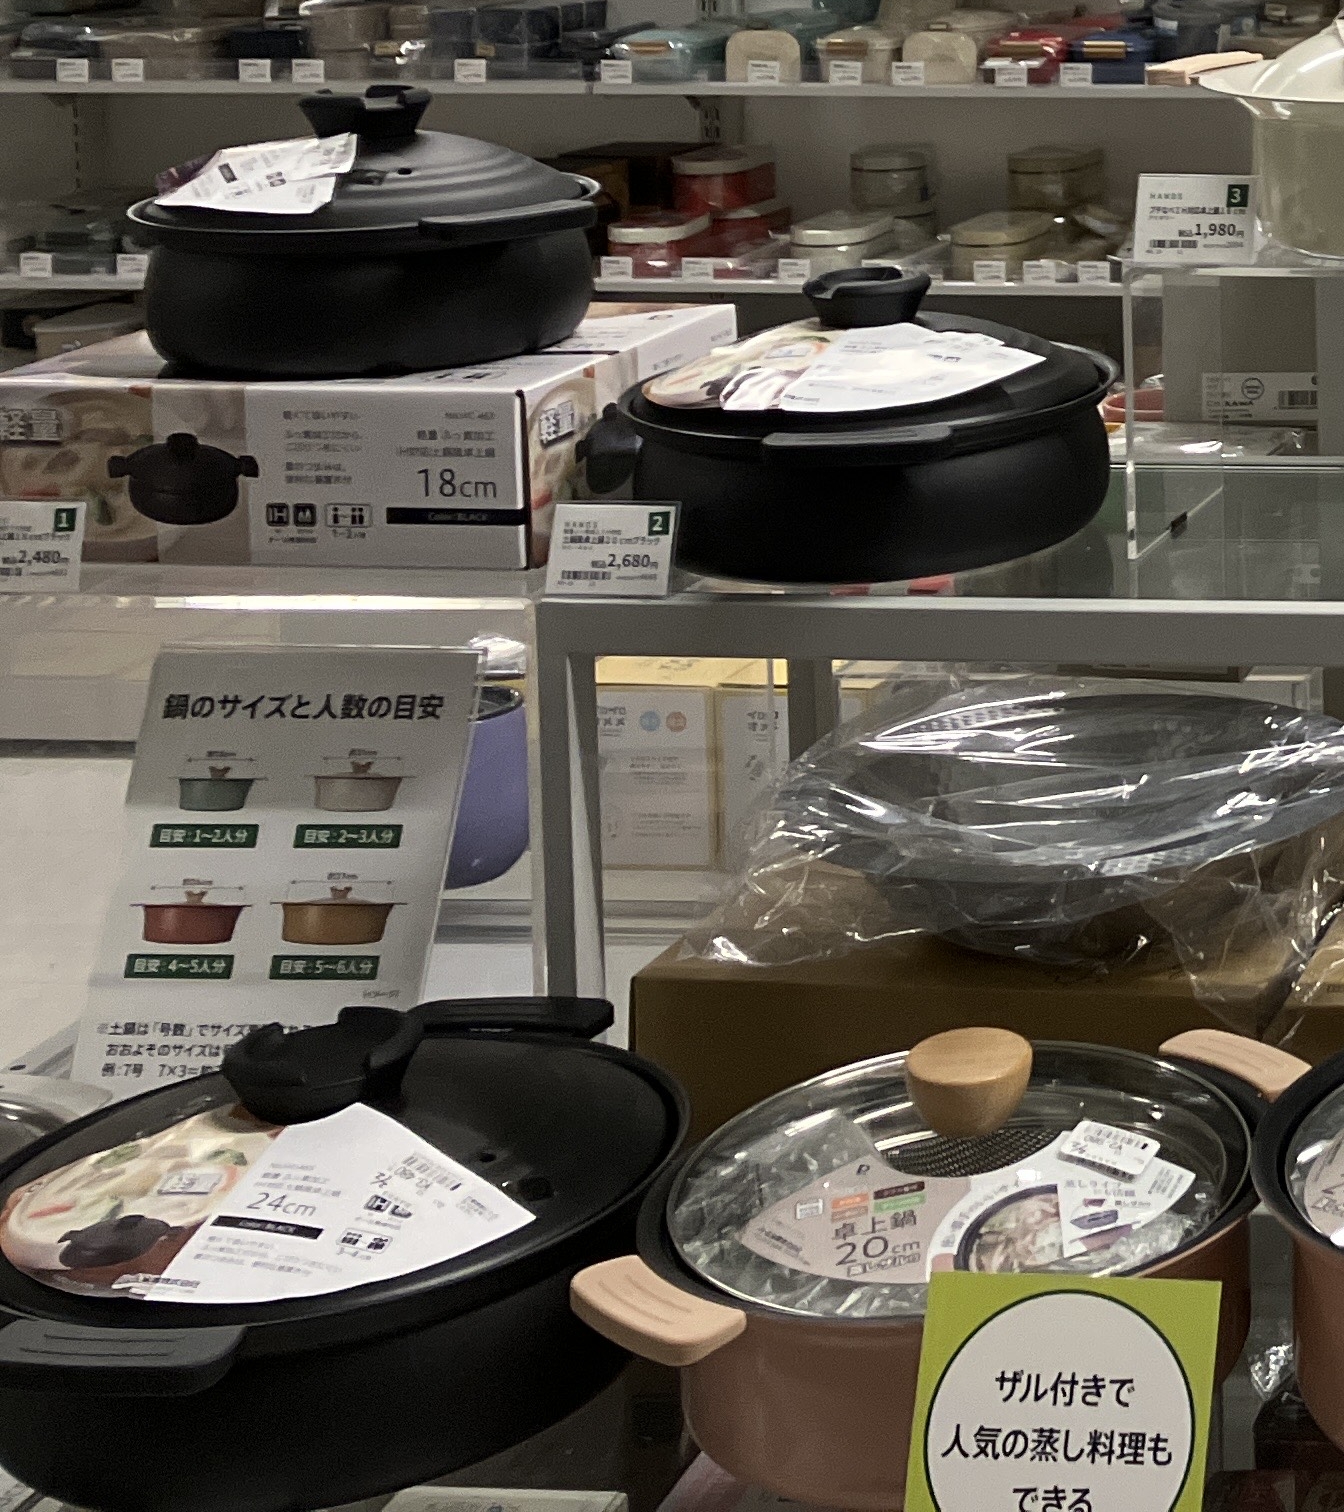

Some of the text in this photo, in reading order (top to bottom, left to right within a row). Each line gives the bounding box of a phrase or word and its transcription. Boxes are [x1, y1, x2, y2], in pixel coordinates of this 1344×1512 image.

[1230, 188, 1241, 203] 3
[416, 468, 497, 497] 18cm
[57, 512, 68, 528] 1
[653, 516, 662, 531] 2
[162, 694, 444, 720] 鍋のサイズと人数の目安
[106, 1044, 231, 1058] おおよそのサイズは
[247, 1192, 316, 1217] 24cm
[832, 1212, 917, 1240] 卓上鍋
[835, 1235, 921, 1266] 20cm
[995, 1370, 1136, 1408] ザル付きで
[941, 1424, 1173, 1466] 人気の蒸し料理も
